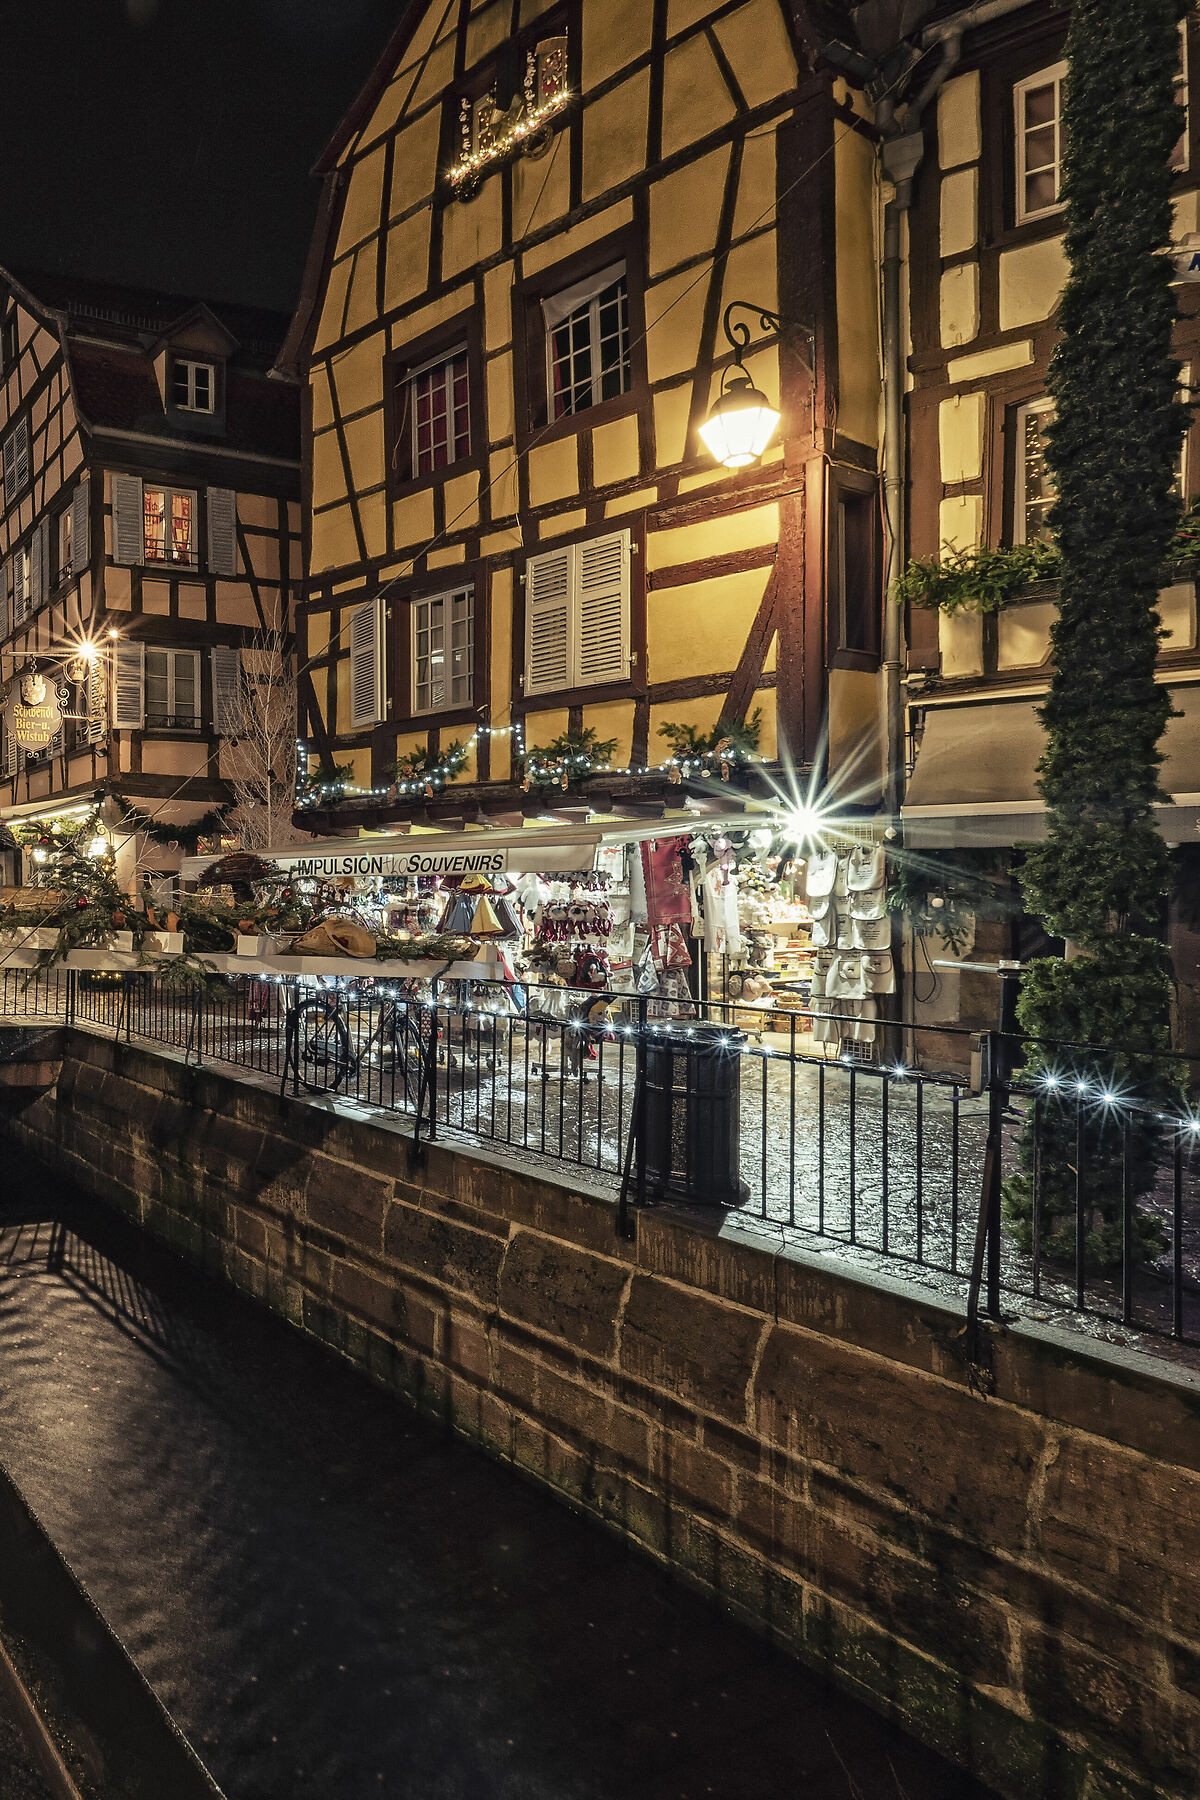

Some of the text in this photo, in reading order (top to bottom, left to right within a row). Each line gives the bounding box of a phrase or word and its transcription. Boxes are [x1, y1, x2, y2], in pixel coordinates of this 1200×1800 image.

[16, 730, 50, 742] Wistub
[297, 854, 504, 876] IMPULSION SOUVENIRS
